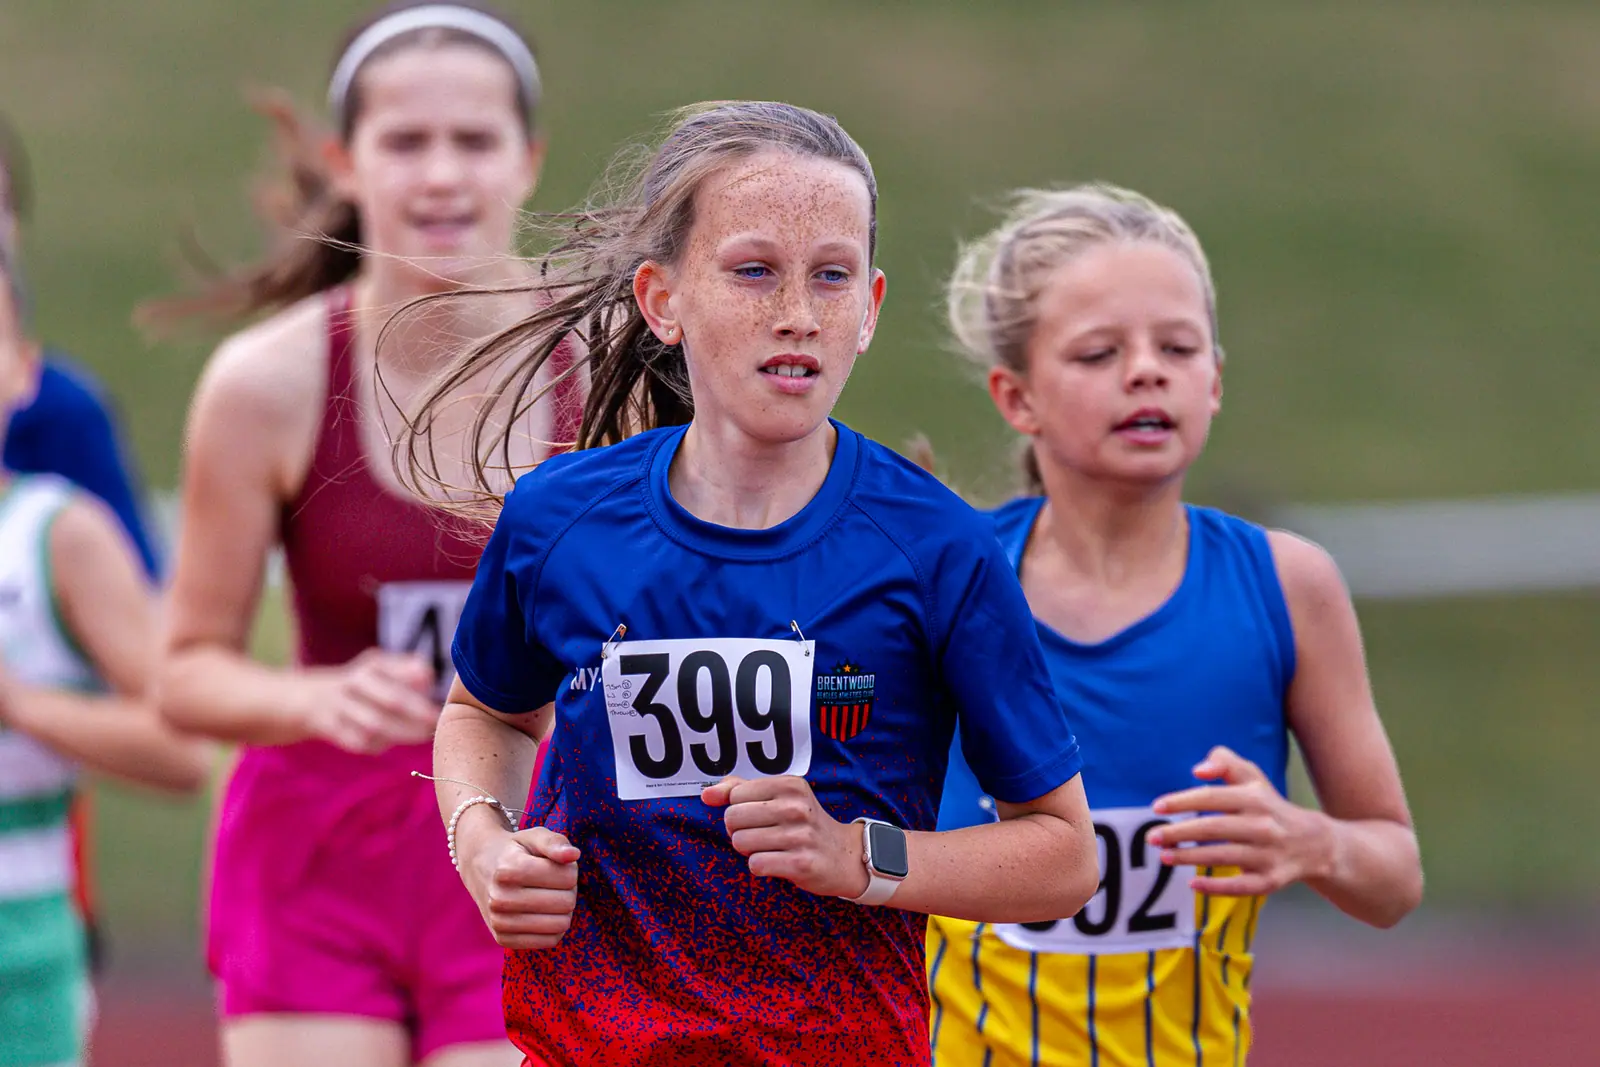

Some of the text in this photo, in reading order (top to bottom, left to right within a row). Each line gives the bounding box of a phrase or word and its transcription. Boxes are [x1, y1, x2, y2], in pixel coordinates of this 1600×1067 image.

[619, 649, 794, 779] 399
[817, 674, 875, 690] BRENTWOOD
[1017, 819, 1176, 935] 92
